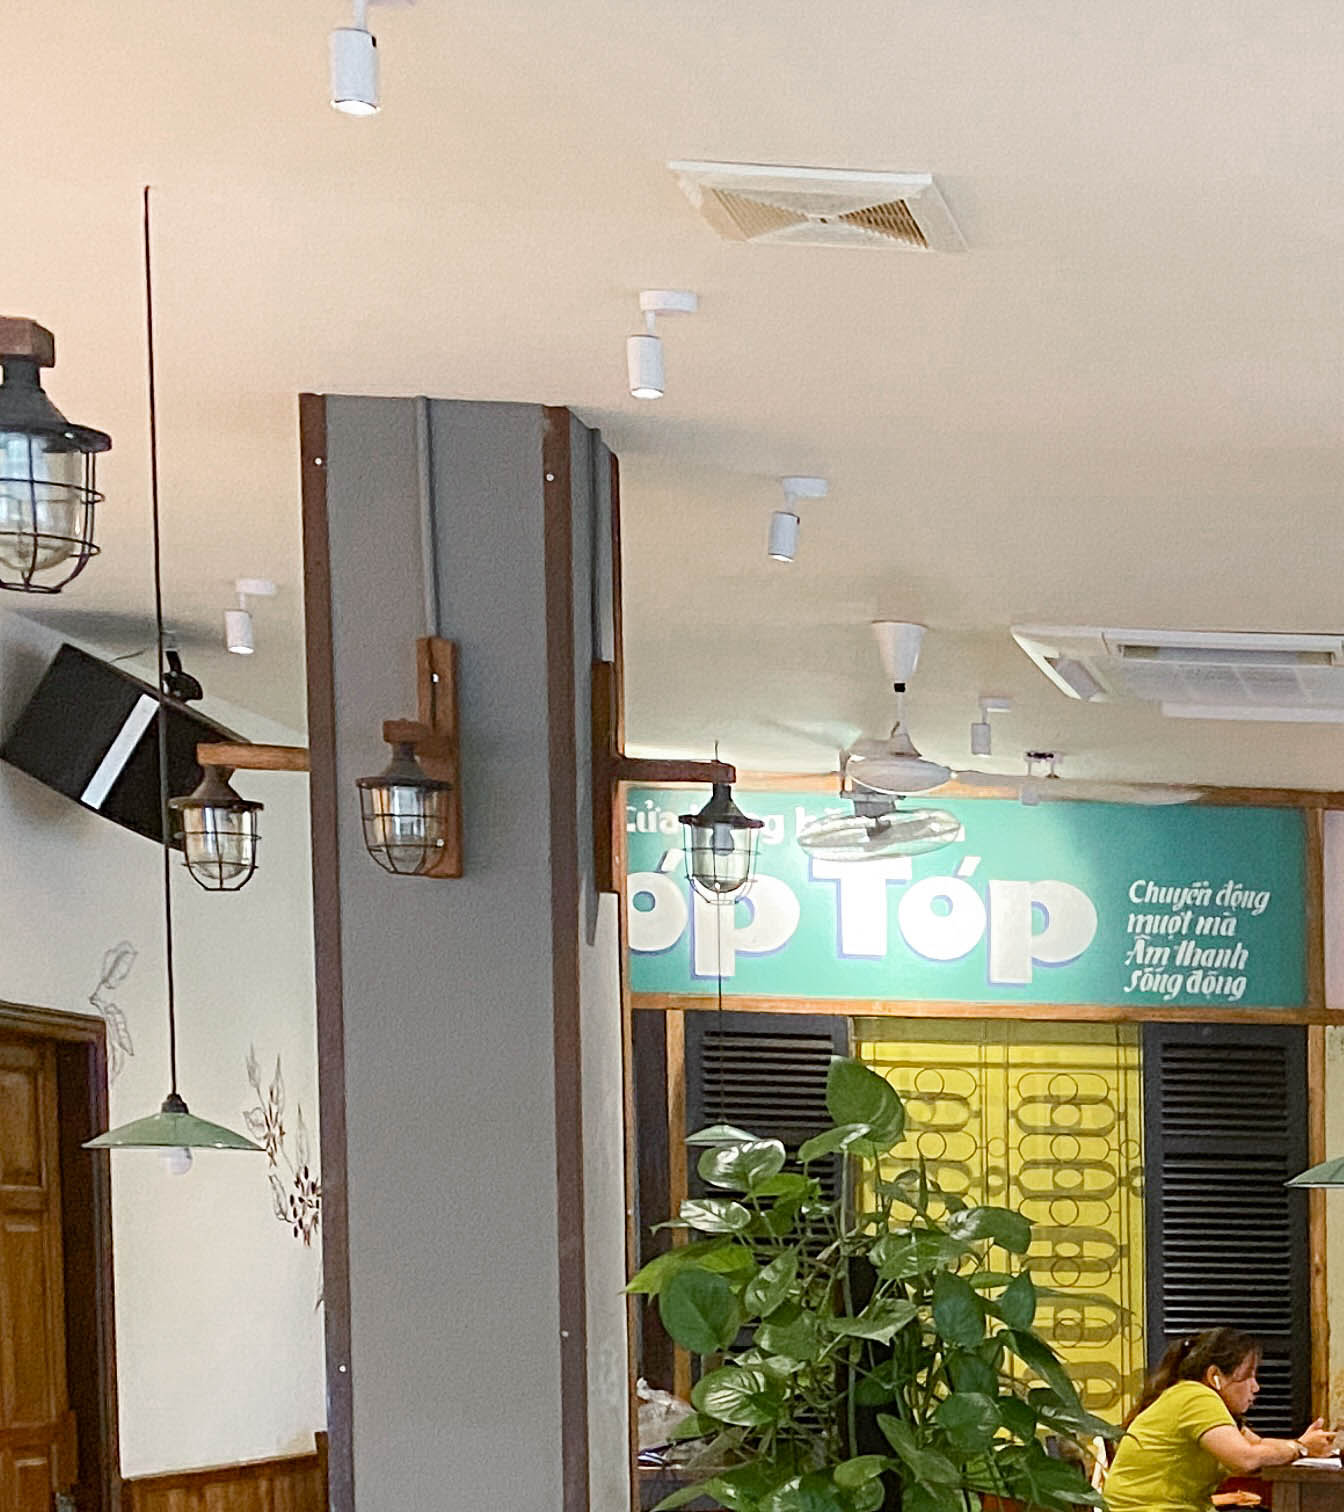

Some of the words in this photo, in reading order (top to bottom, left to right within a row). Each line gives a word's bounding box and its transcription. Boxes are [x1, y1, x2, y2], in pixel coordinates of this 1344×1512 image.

[1215, 879, 1271, 916] động
[809, 855, 1098, 985] Tóp
[1174, 939, 1249, 970] thanh
[1186, 969, 1248, 1001] động
